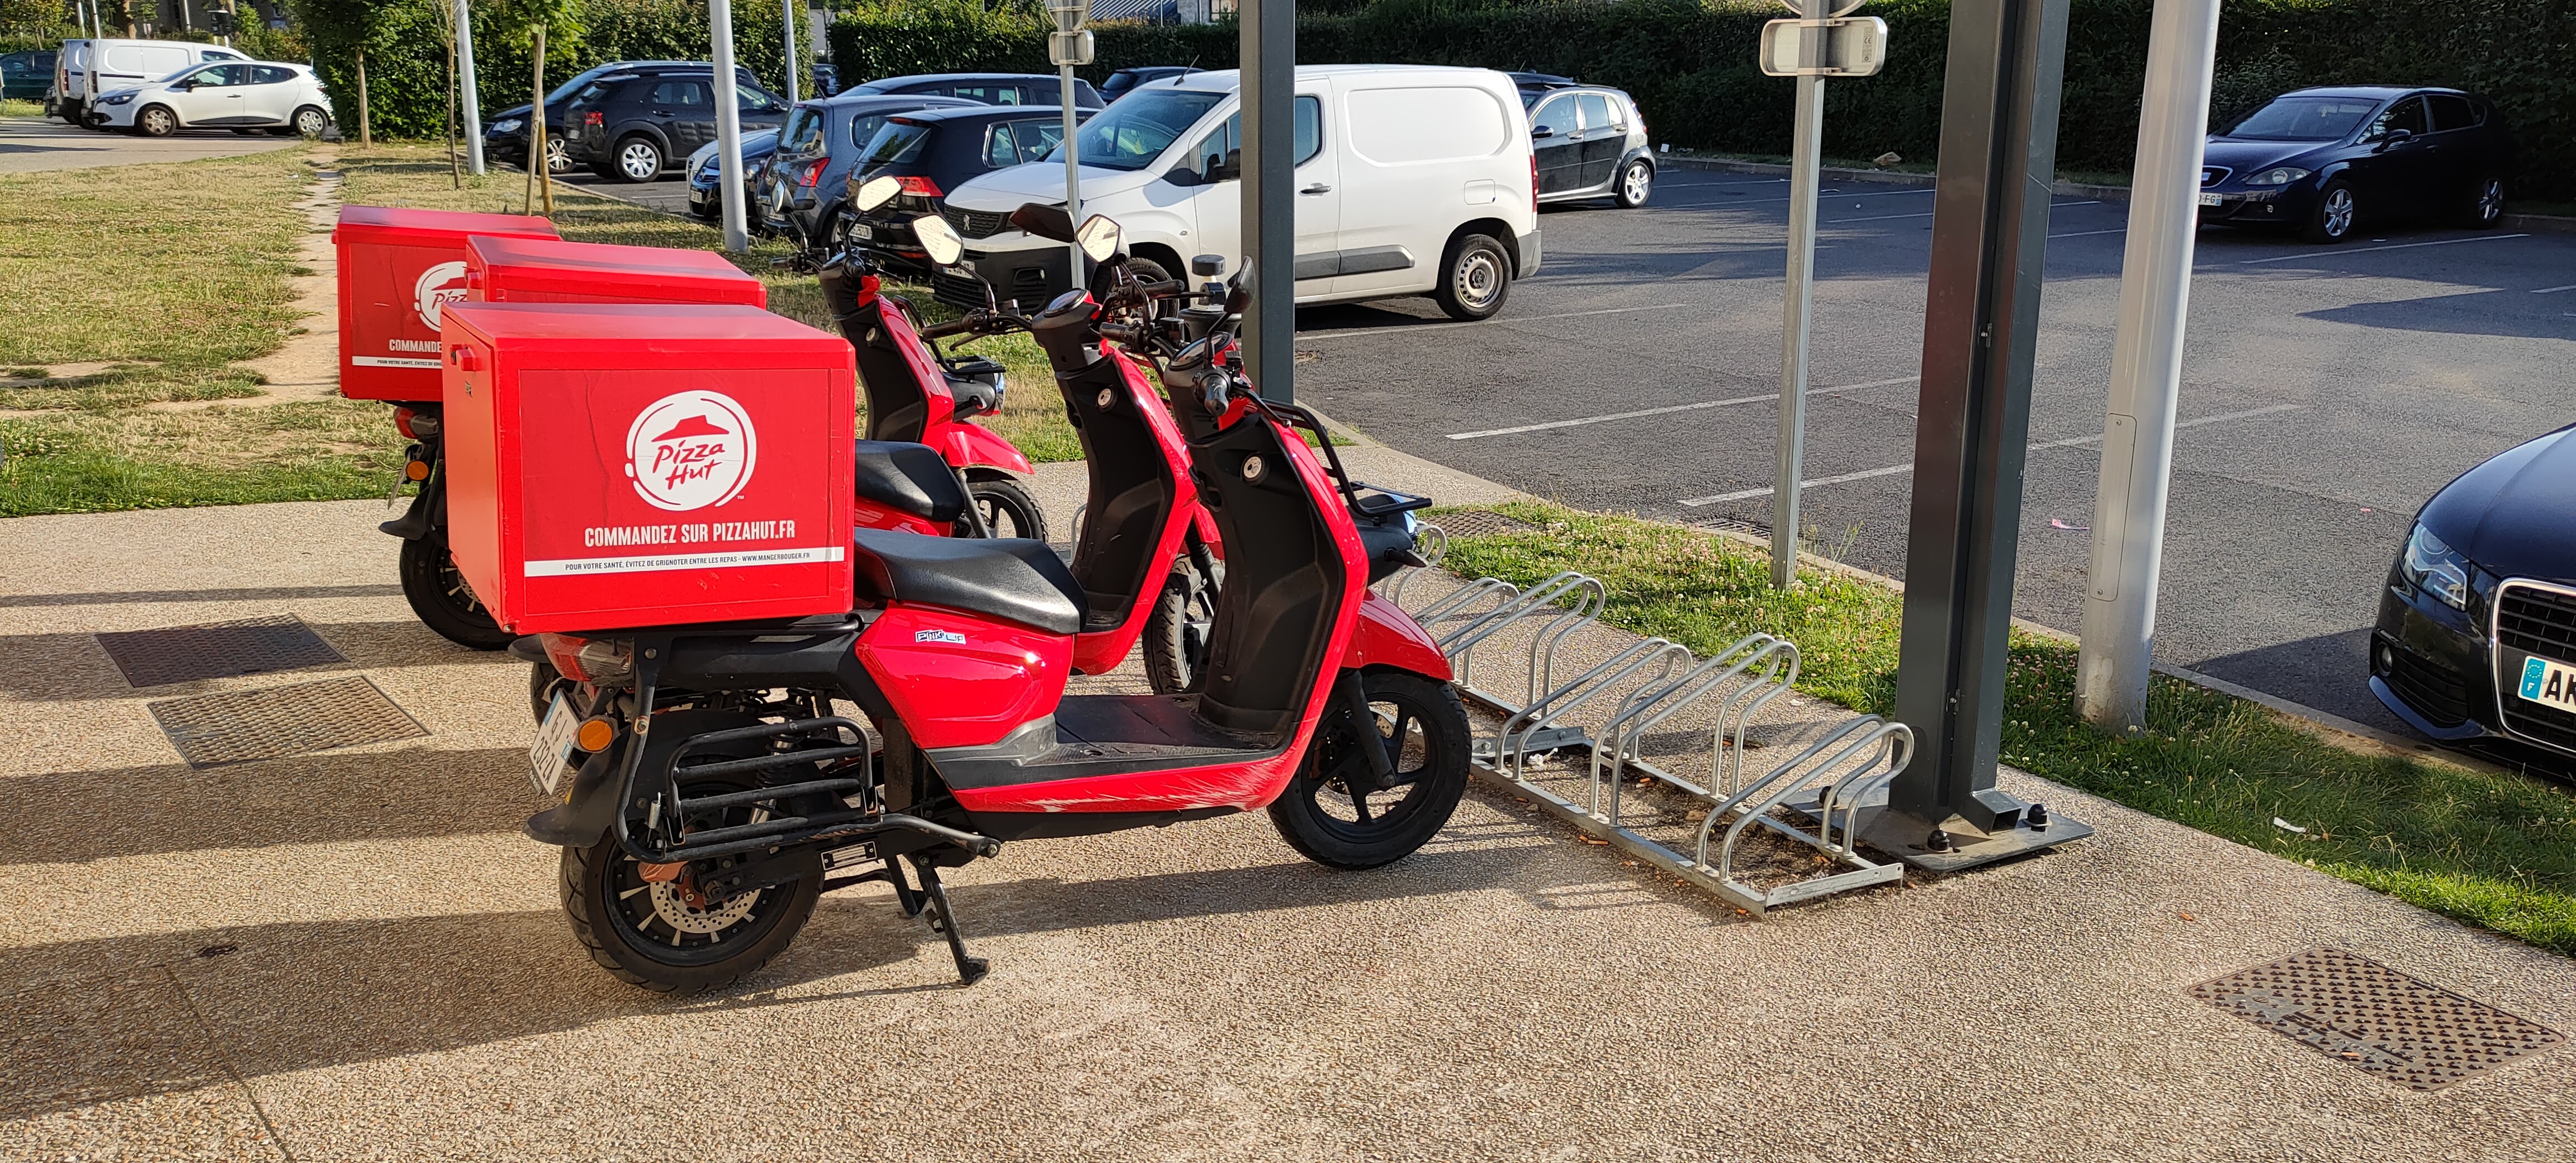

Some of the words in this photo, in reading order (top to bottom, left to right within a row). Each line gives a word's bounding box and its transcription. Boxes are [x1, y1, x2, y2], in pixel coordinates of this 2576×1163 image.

[432, 291, 467, 310] Pizz
[389, 339, 442, 352] COMMANDE
[652, 439, 726, 474] Pizza
[665, 459, 722, 490] Hut
[585, 525, 677, 547] COMMANDEZ
[681, 523, 708, 543] SUR
[713, 520, 795, 541] PIZZAHUT.FR
[742, 552, 810, 561] WWW.MANGERBOUGER.FR
[2527, 682, 2535, 692] F
